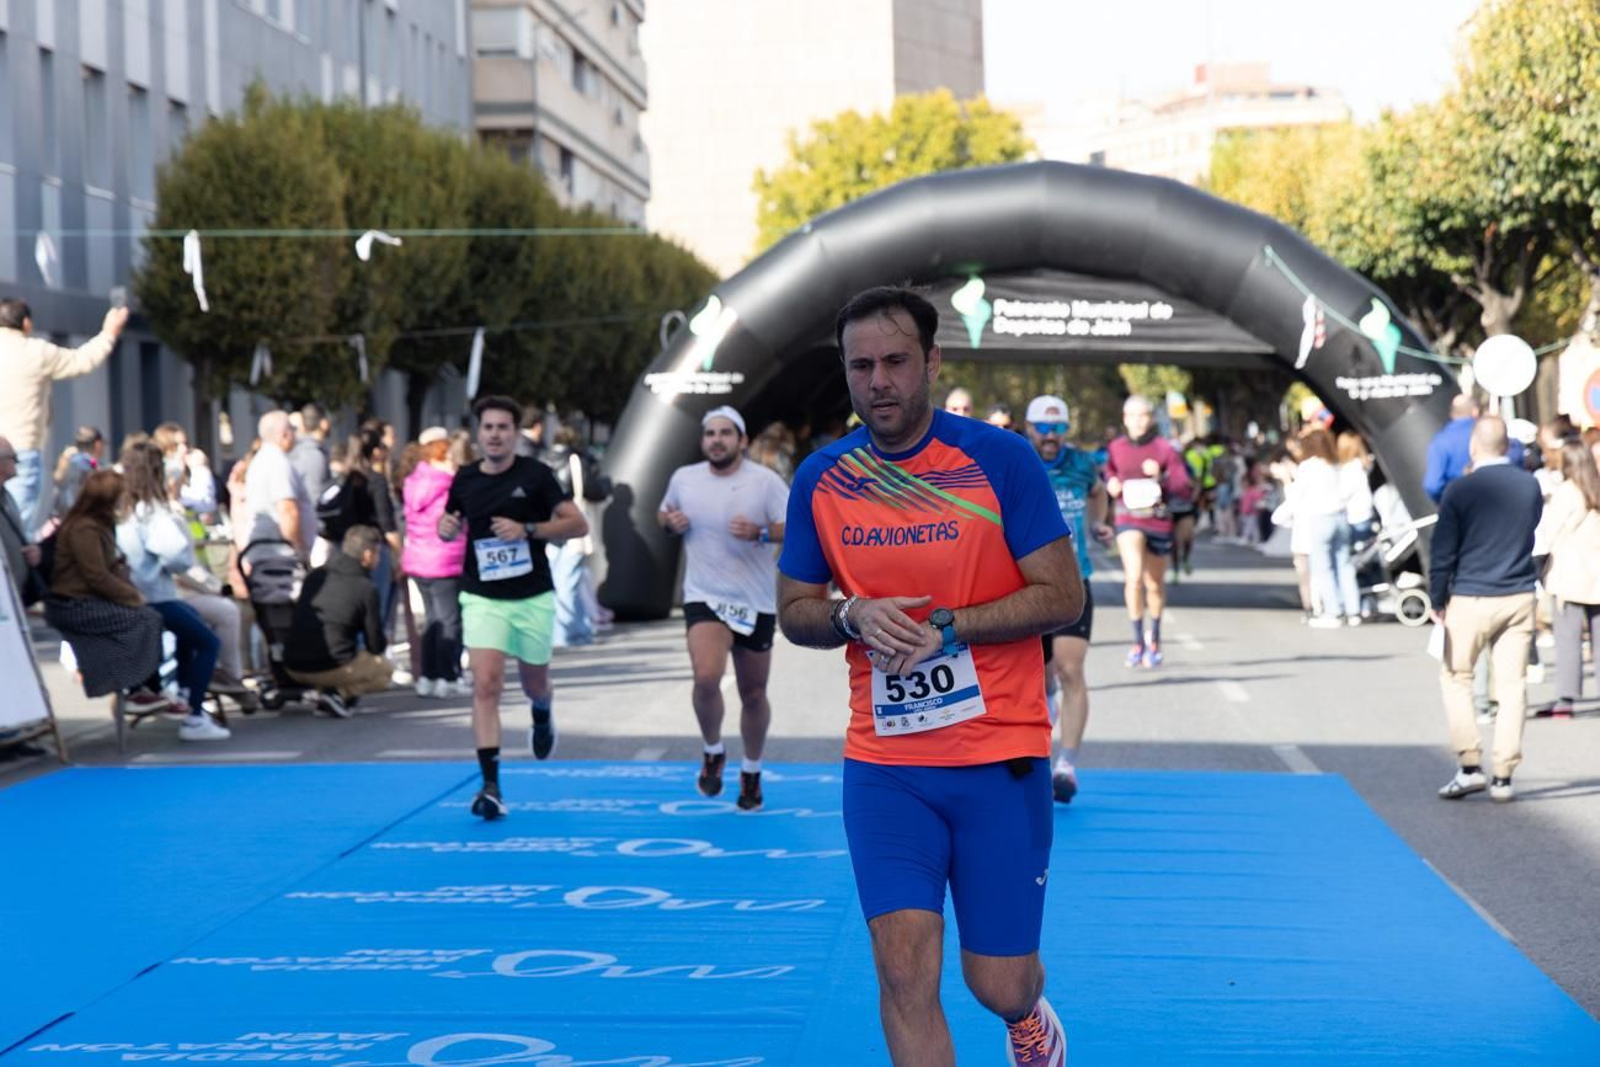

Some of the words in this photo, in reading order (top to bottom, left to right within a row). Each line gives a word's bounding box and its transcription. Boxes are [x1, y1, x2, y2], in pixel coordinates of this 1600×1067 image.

[1071, 300, 1149, 319] Municipal
[1150, 301, 1173, 320] de
[486, 547, 518, 565] 567
[885, 664, 955, 703] 530
[903, 697, 944, 712] FRANCISCO
